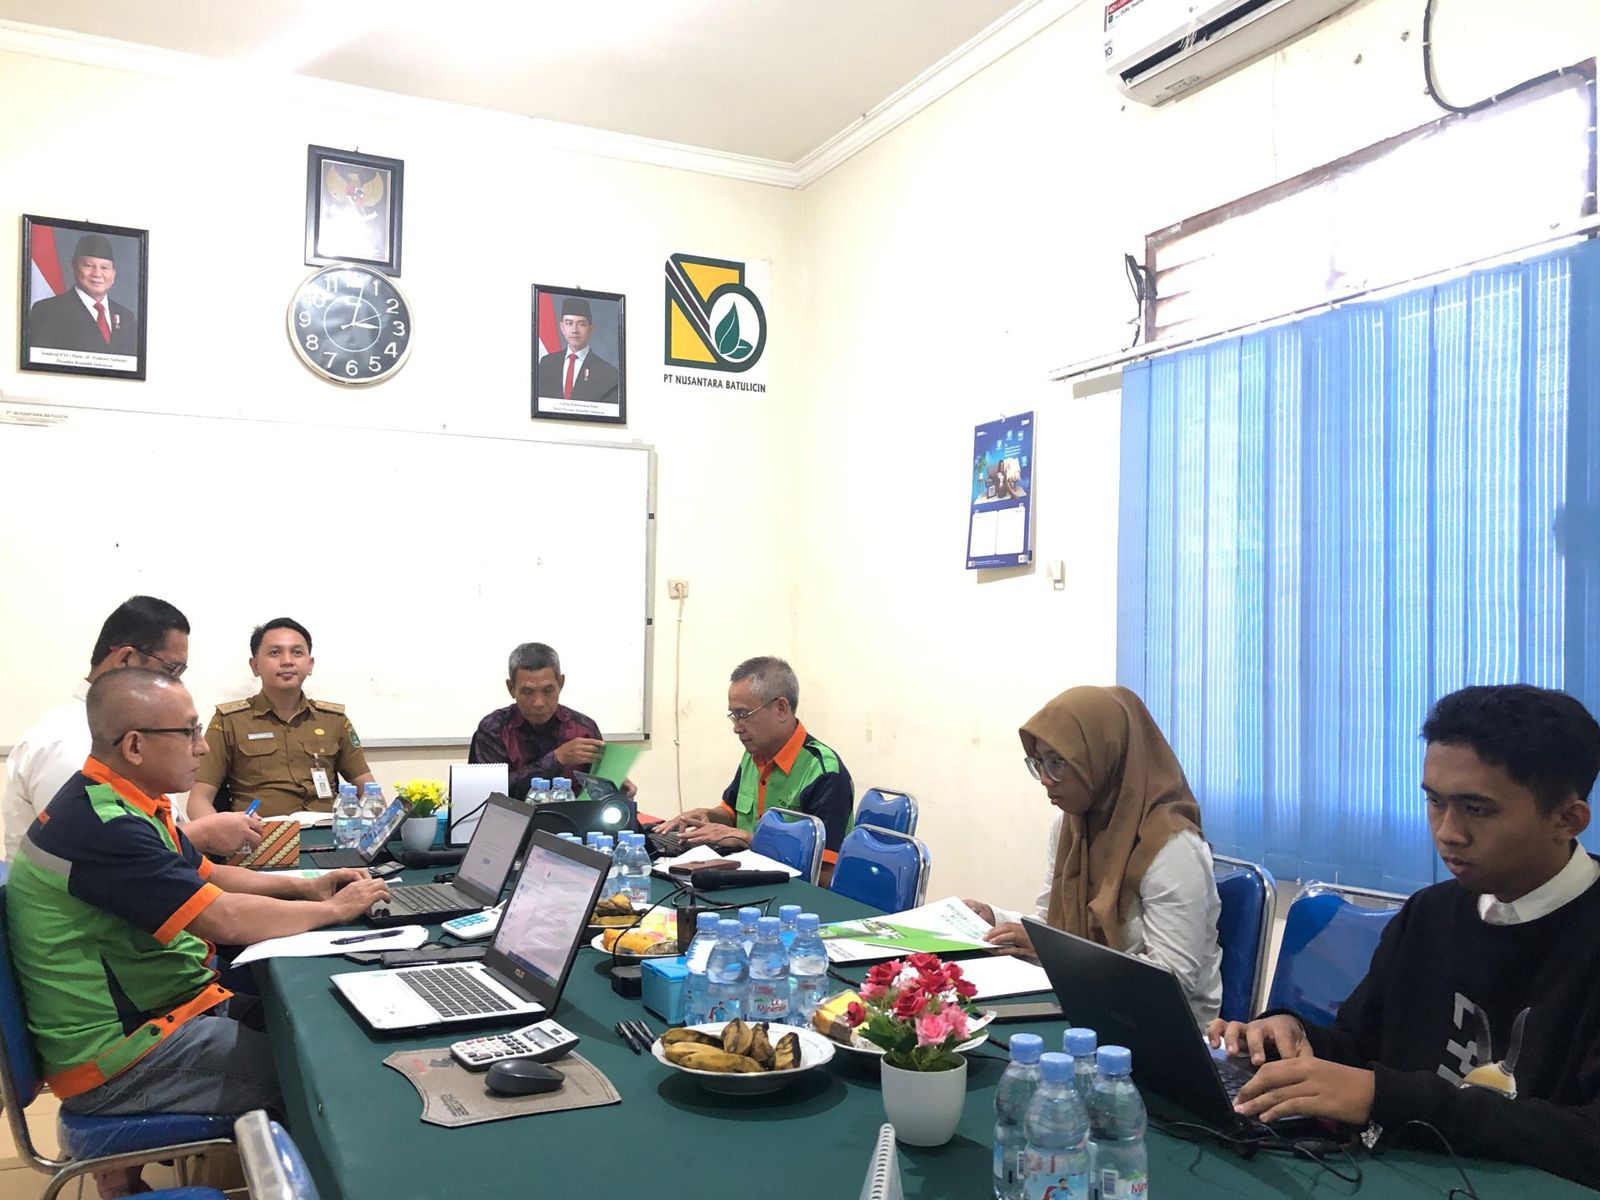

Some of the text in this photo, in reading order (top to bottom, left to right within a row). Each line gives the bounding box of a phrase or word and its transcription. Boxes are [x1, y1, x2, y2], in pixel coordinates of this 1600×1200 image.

[325, 276, 338, 293] 11
[373, 279, 379, 296] 1
[386, 298, 399, 314] 2
[298, 311, 311, 328] 9
[392, 320, 406, 337] 3
[305, 334, 319, 351] 8
[383, 341, 398, 358] 4
[323, 351, 338, 369] 7
[345, 359, 359, 376] 6
[368, 356, 382, 372] 5
[663, 373, 766, 393] PT NUSANTARA BATULICIN
